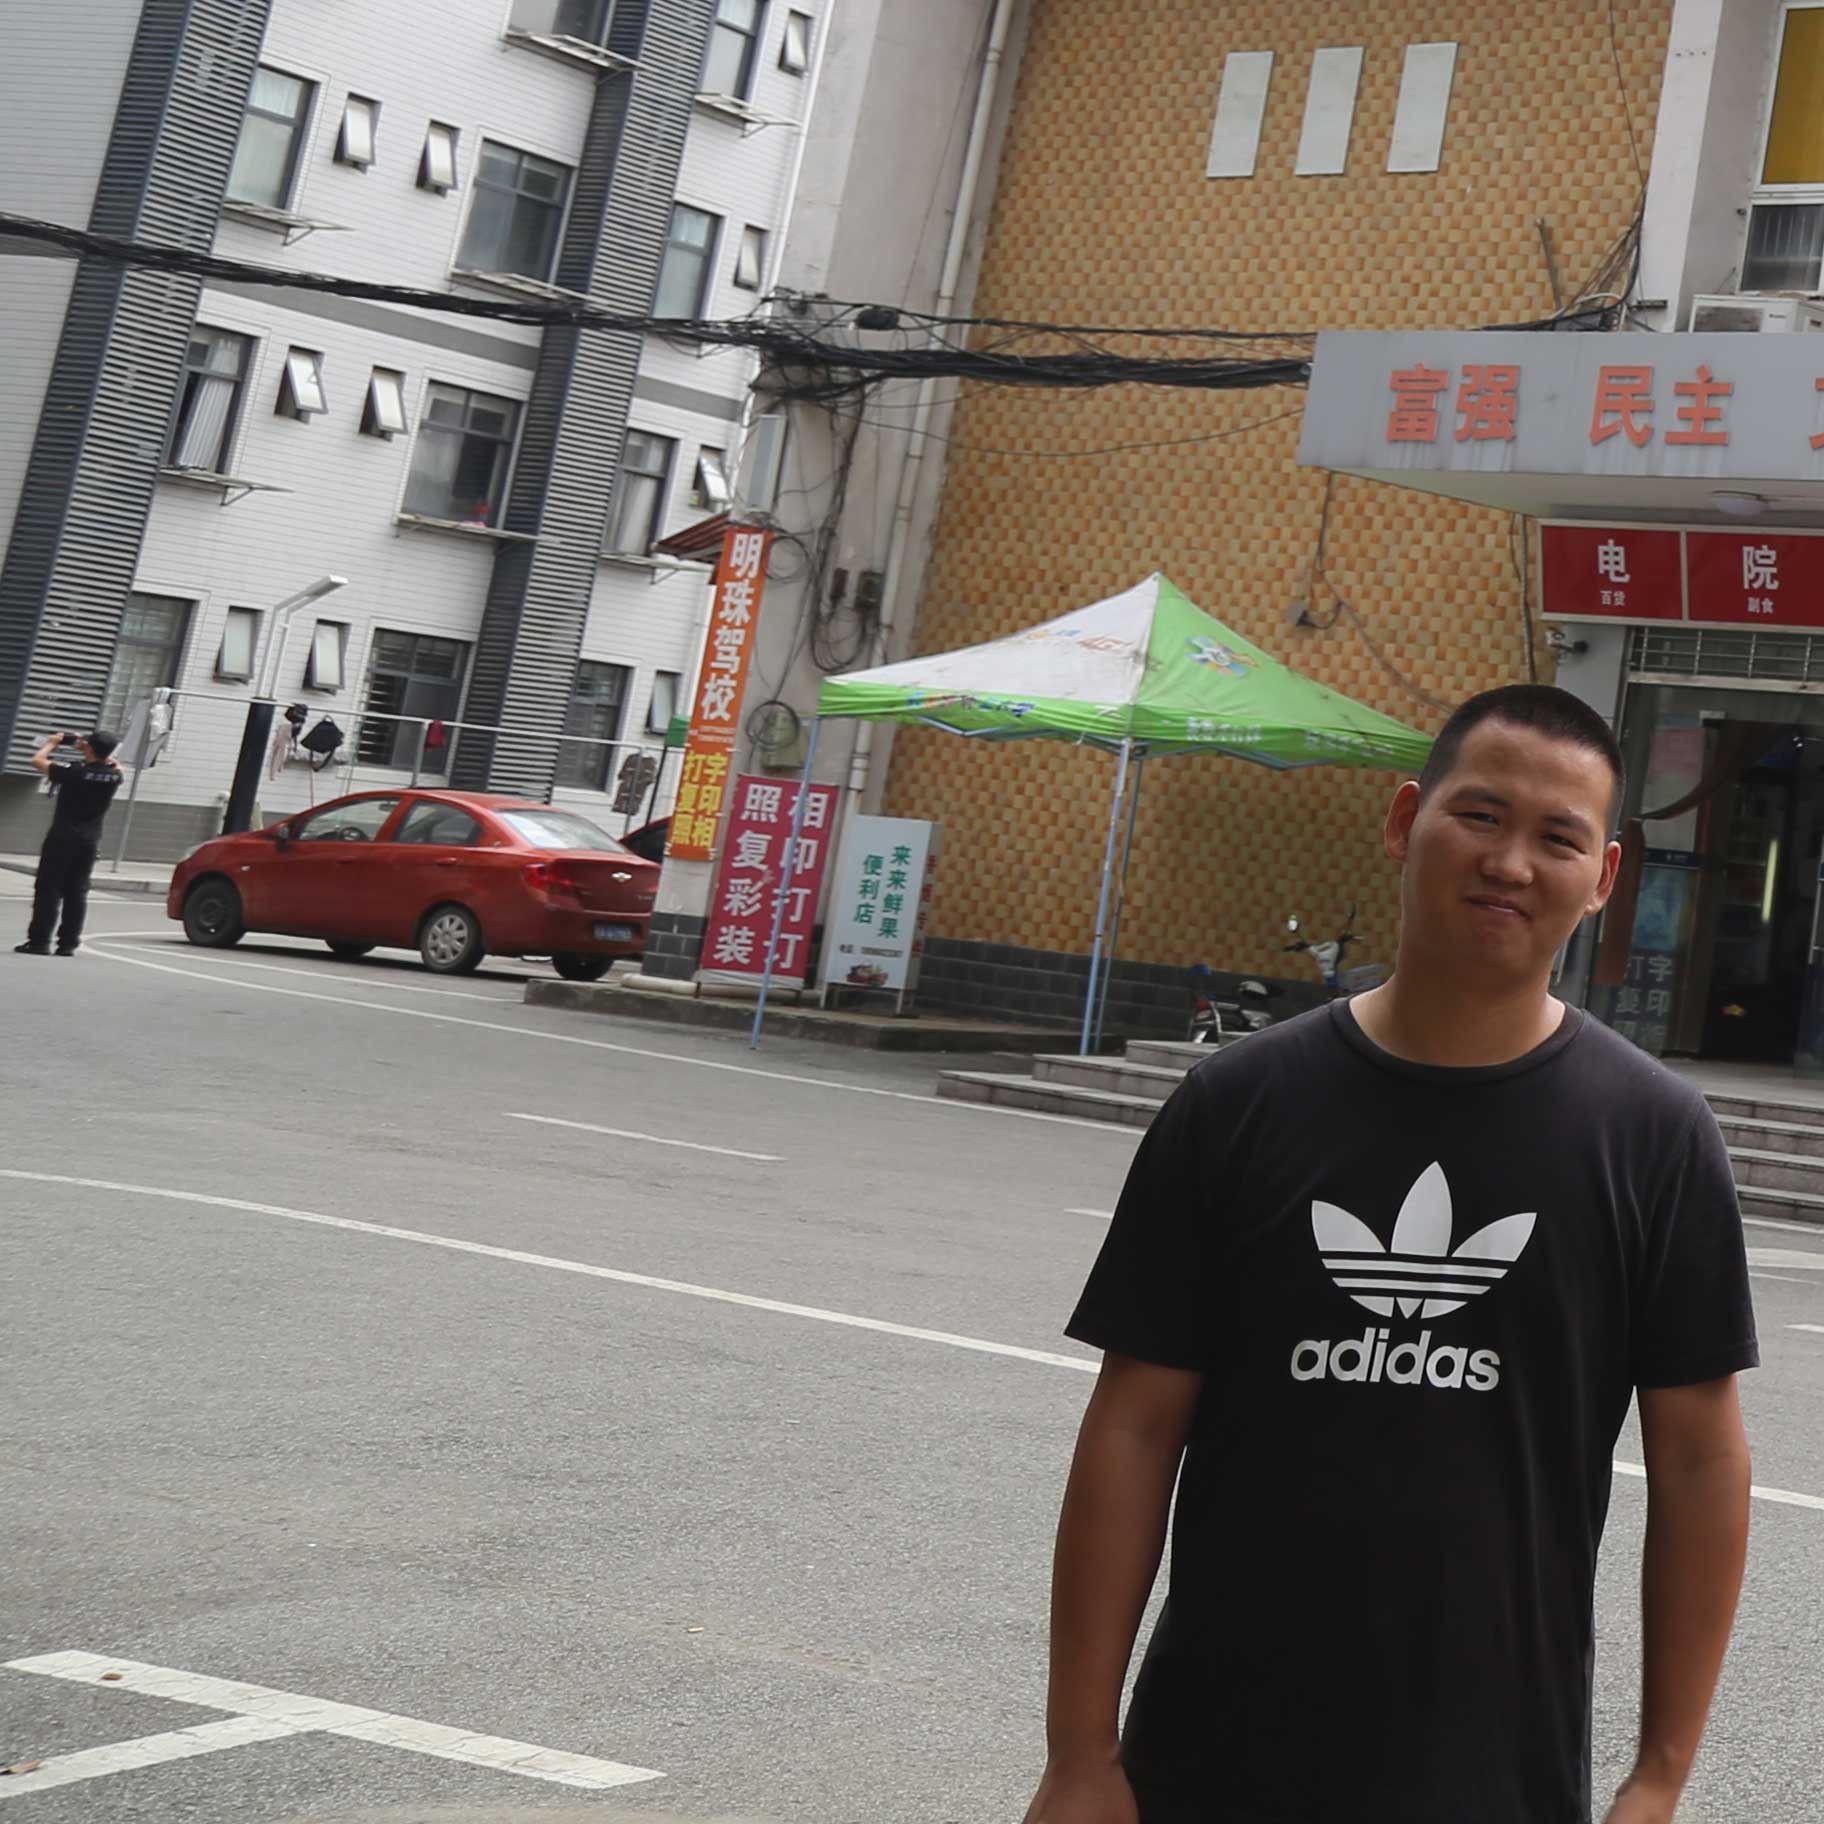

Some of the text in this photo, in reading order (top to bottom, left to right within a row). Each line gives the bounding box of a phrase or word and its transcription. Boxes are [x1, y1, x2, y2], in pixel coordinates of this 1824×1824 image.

[1386, 362, 1519, 444] 富强
[1589, 365, 1732, 447] 民主
[1601, 590, 1625, 606] 百货
[1748, 597, 1773, 613] 副食
[701, 533, 764, 722] 明珠驾校
[683, 750, 728, 783] 打字
[674, 782, 722, 815] 复印
[740, 783, 828, 828] 照相
[672, 814, 717, 847] 照相
[731, 830, 819, 875] 复印
[723, 878, 811, 922] 彩打
[853, 854, 884, 924] 便利店
[877, 845, 912, 939] 来来鲜果
[713, 925, 803, 969] 装订
[1291, 1326, 1501, 1391] adidas
